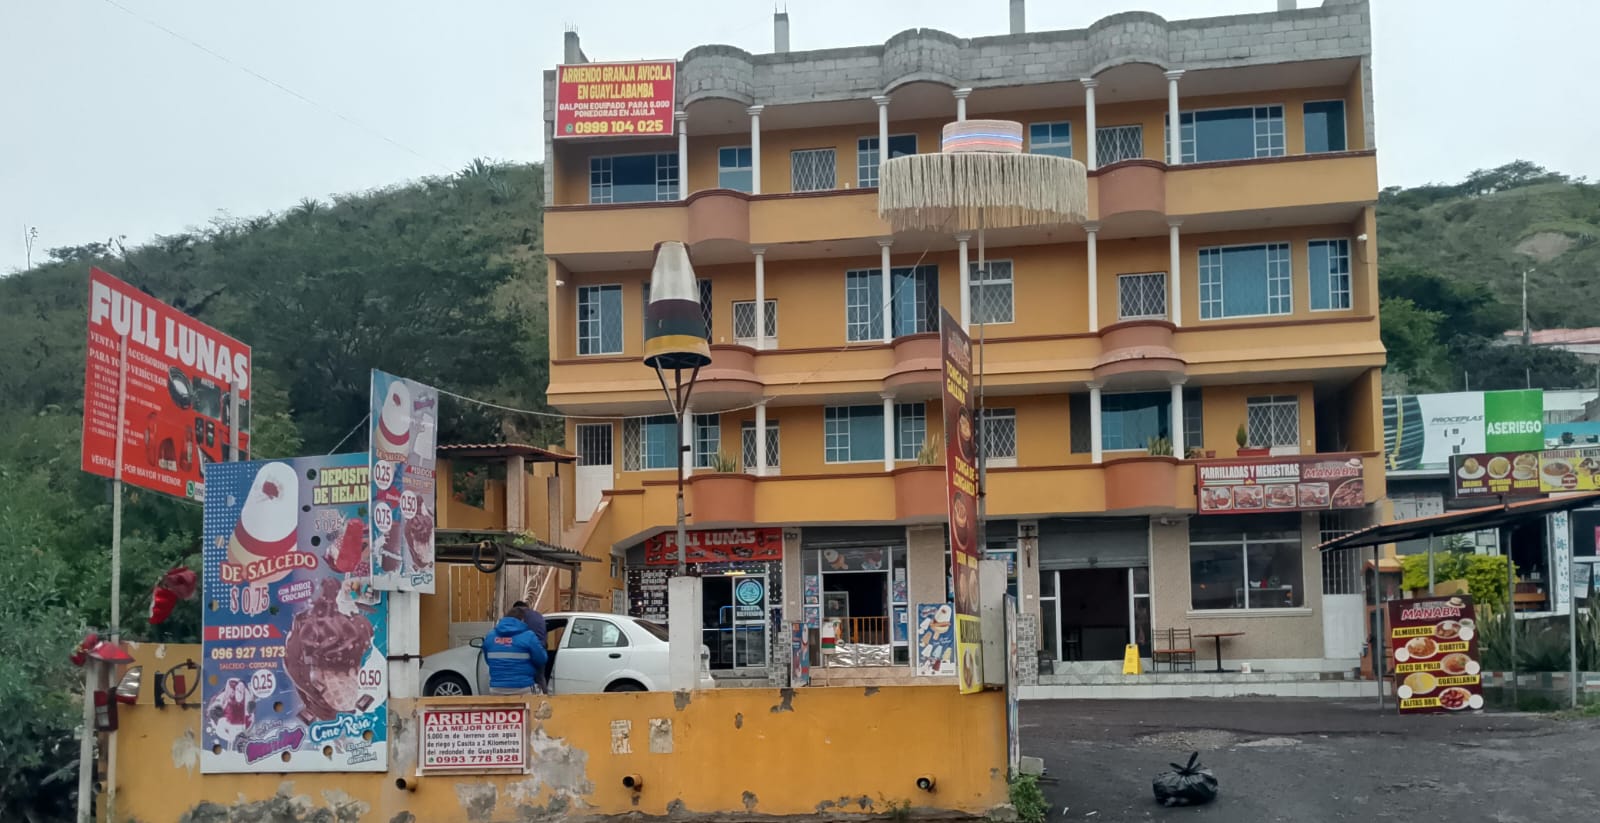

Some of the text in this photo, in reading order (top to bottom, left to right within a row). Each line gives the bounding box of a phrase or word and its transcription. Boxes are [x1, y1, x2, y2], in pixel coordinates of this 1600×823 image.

[562, 65, 672, 83] ARRIENDO GRANJA AVICOLA
[577, 82, 654, 100] EN GUAYLLABAMBA
[560, 103, 588, 111] GALPON
[590, 102, 626, 110] EQUIPADO
[628, 101, 648, 109] PARA
[574, 110, 618, 118] PONEDORAS
[630, 108, 656, 116] JAULA
[575, 120, 664, 134] 0999 104 025
[90, 331, 114, 350] VENTA
[91, 280, 248, 391] FULL LUNAS
[89, 347, 110, 364] PARA
[111, 356, 130, 371] TOO
[1486, 420, 1542, 435] ASERIEGO
[124, 464, 136, 473] POR
[376, 464, 390, 482] 0.25
[1200, 465, 1248, 479] PARRILLADAS
[1250, 465, 1255, 478] Y
[1256, 464, 1300, 477] MENESTRAS
[1304, 468, 1359, 479] MANABA
[320, 467, 369, 486] DEPOSIT
[314, 485, 368, 505] DE HELAD
[402, 495, 416, 512] 0.50
[376, 508, 390, 525] 0.75
[704, 531, 756, 546] LUNAS
[222, 553, 316, 582] DE SALCEDO
[1401, 607, 1461, 620] MANABA
[218, 624, 270, 640] PEDIDOS
[1394, 627, 1432, 636] ALMUERZOS
[212, 646, 286, 660] 096 927 1973
[220, 662, 245, 670] SALCEDO
[252, 673, 273, 691] 0.25
[360, 670, 382, 686] 0.50
[426, 711, 521, 726] ARRIENDO
[436, 756, 466, 764] 0993
[496, 754, 519, 762] 928
